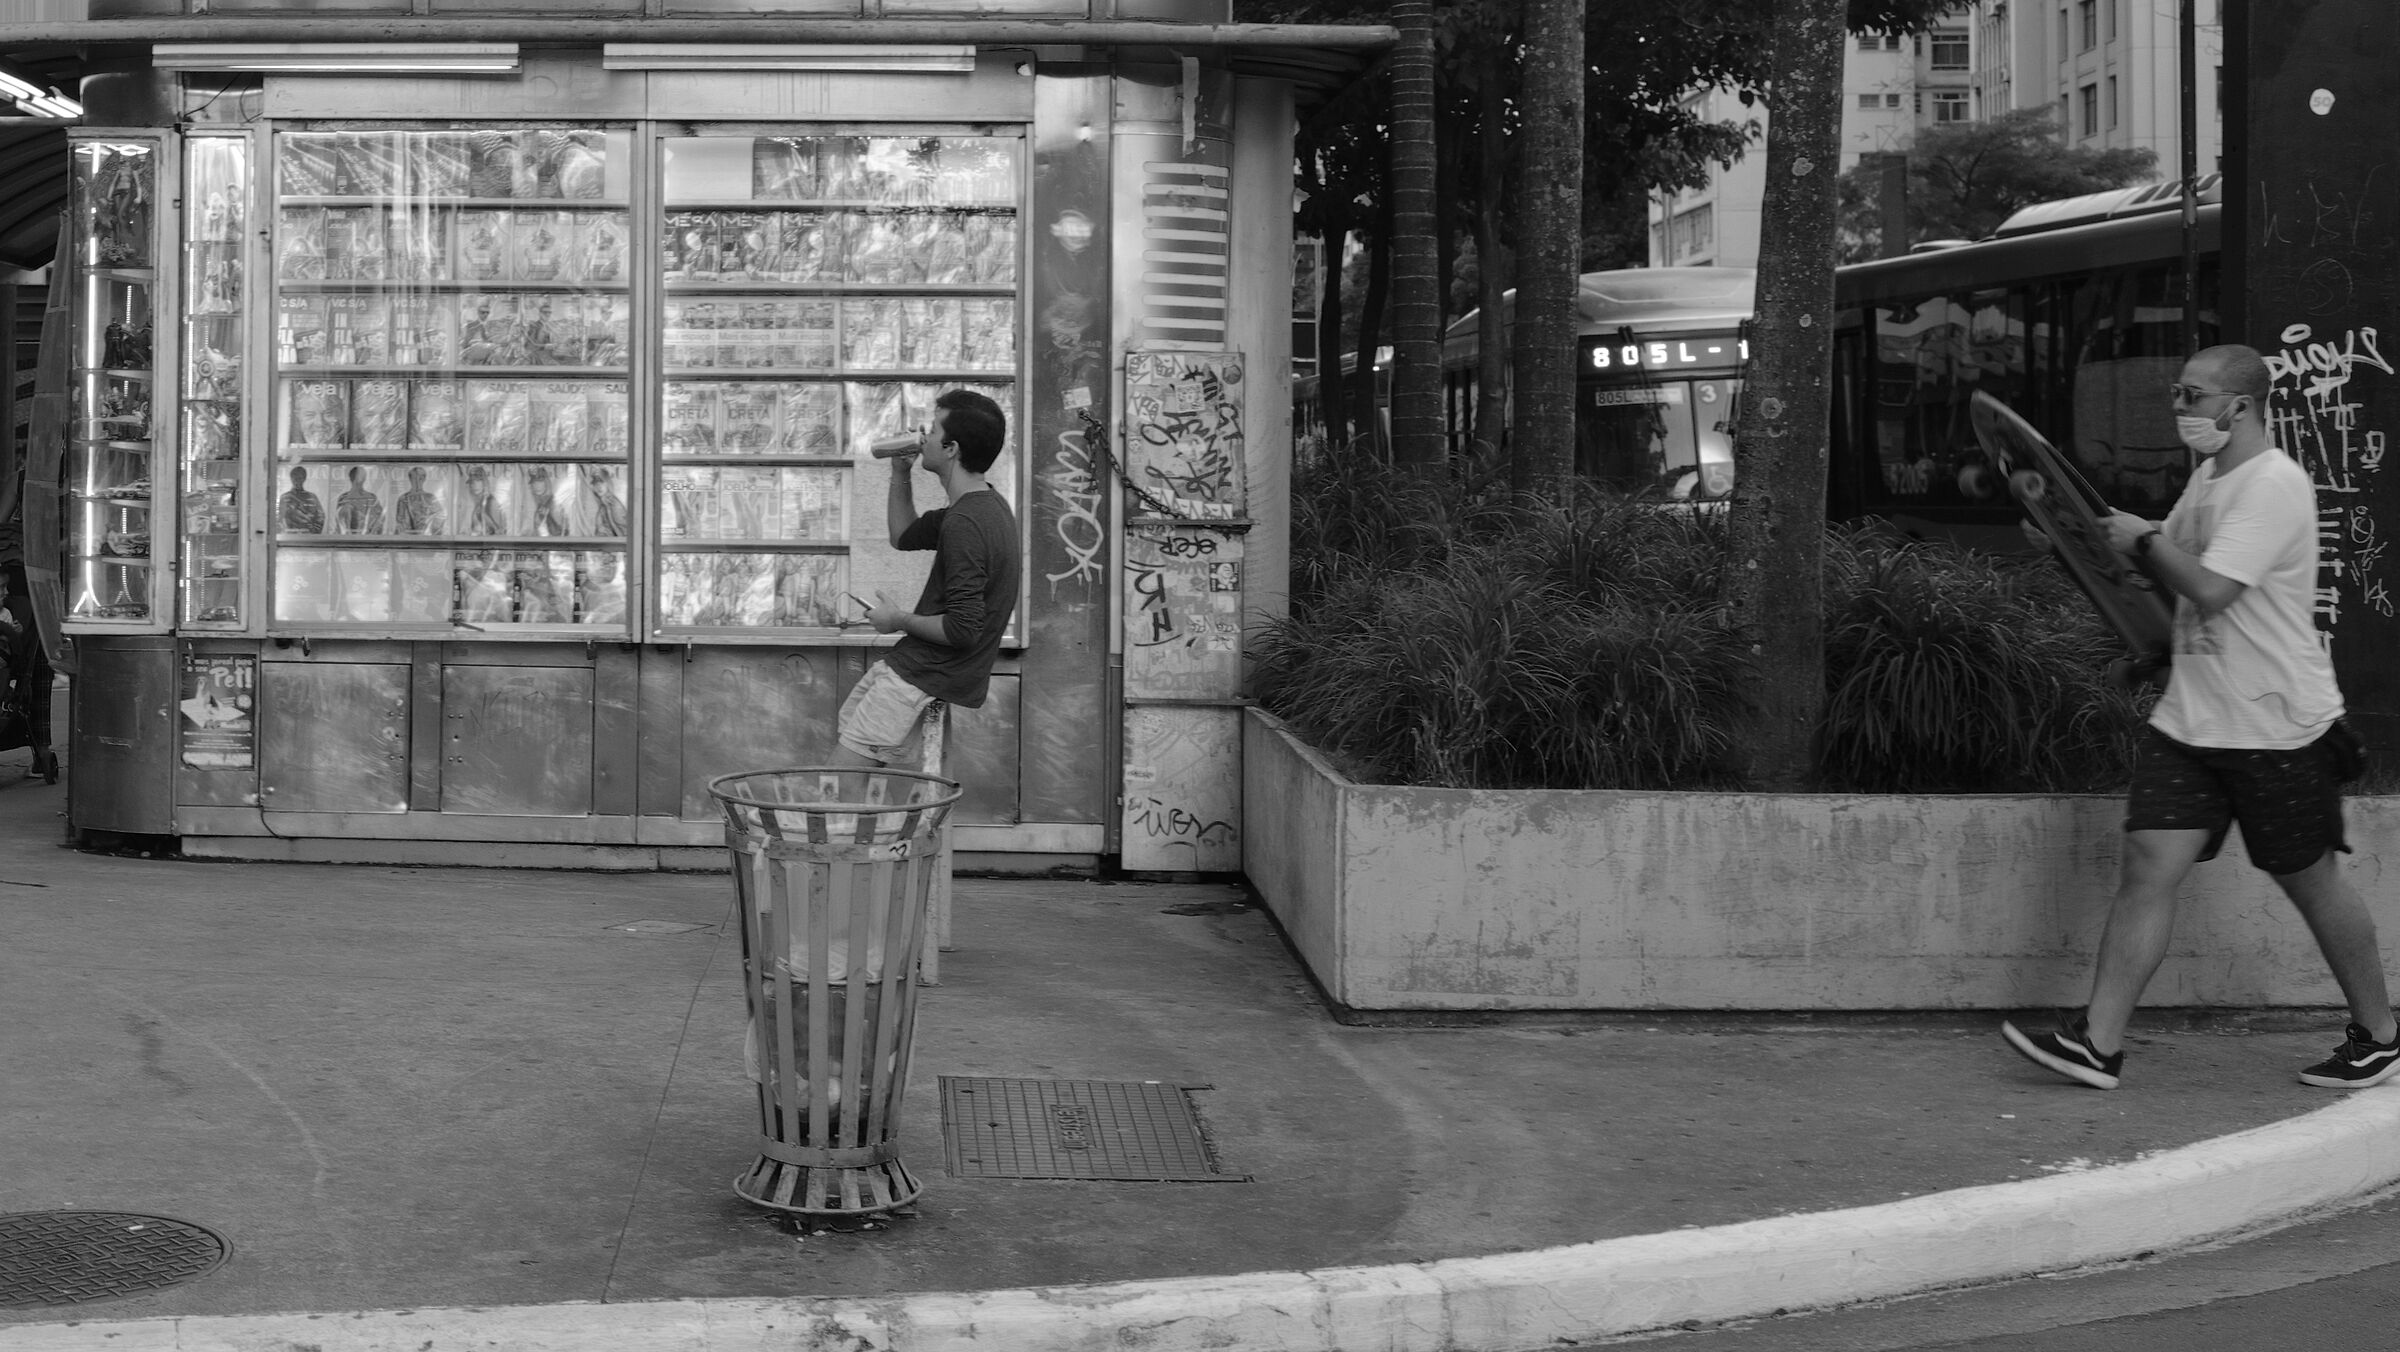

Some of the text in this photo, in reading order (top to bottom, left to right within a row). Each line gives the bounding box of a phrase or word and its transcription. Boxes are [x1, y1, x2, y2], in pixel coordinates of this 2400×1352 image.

[301, 382, 337, 398] veja
[420, 382, 455, 398] veja
[1597, 390, 1632, 404] 805L
[1700, 384, 1717, 403] 3
[668, 408, 709, 420] CRETA
[728, 408, 770, 420] CRETA
[209, 666, 253, 689] Pet!
